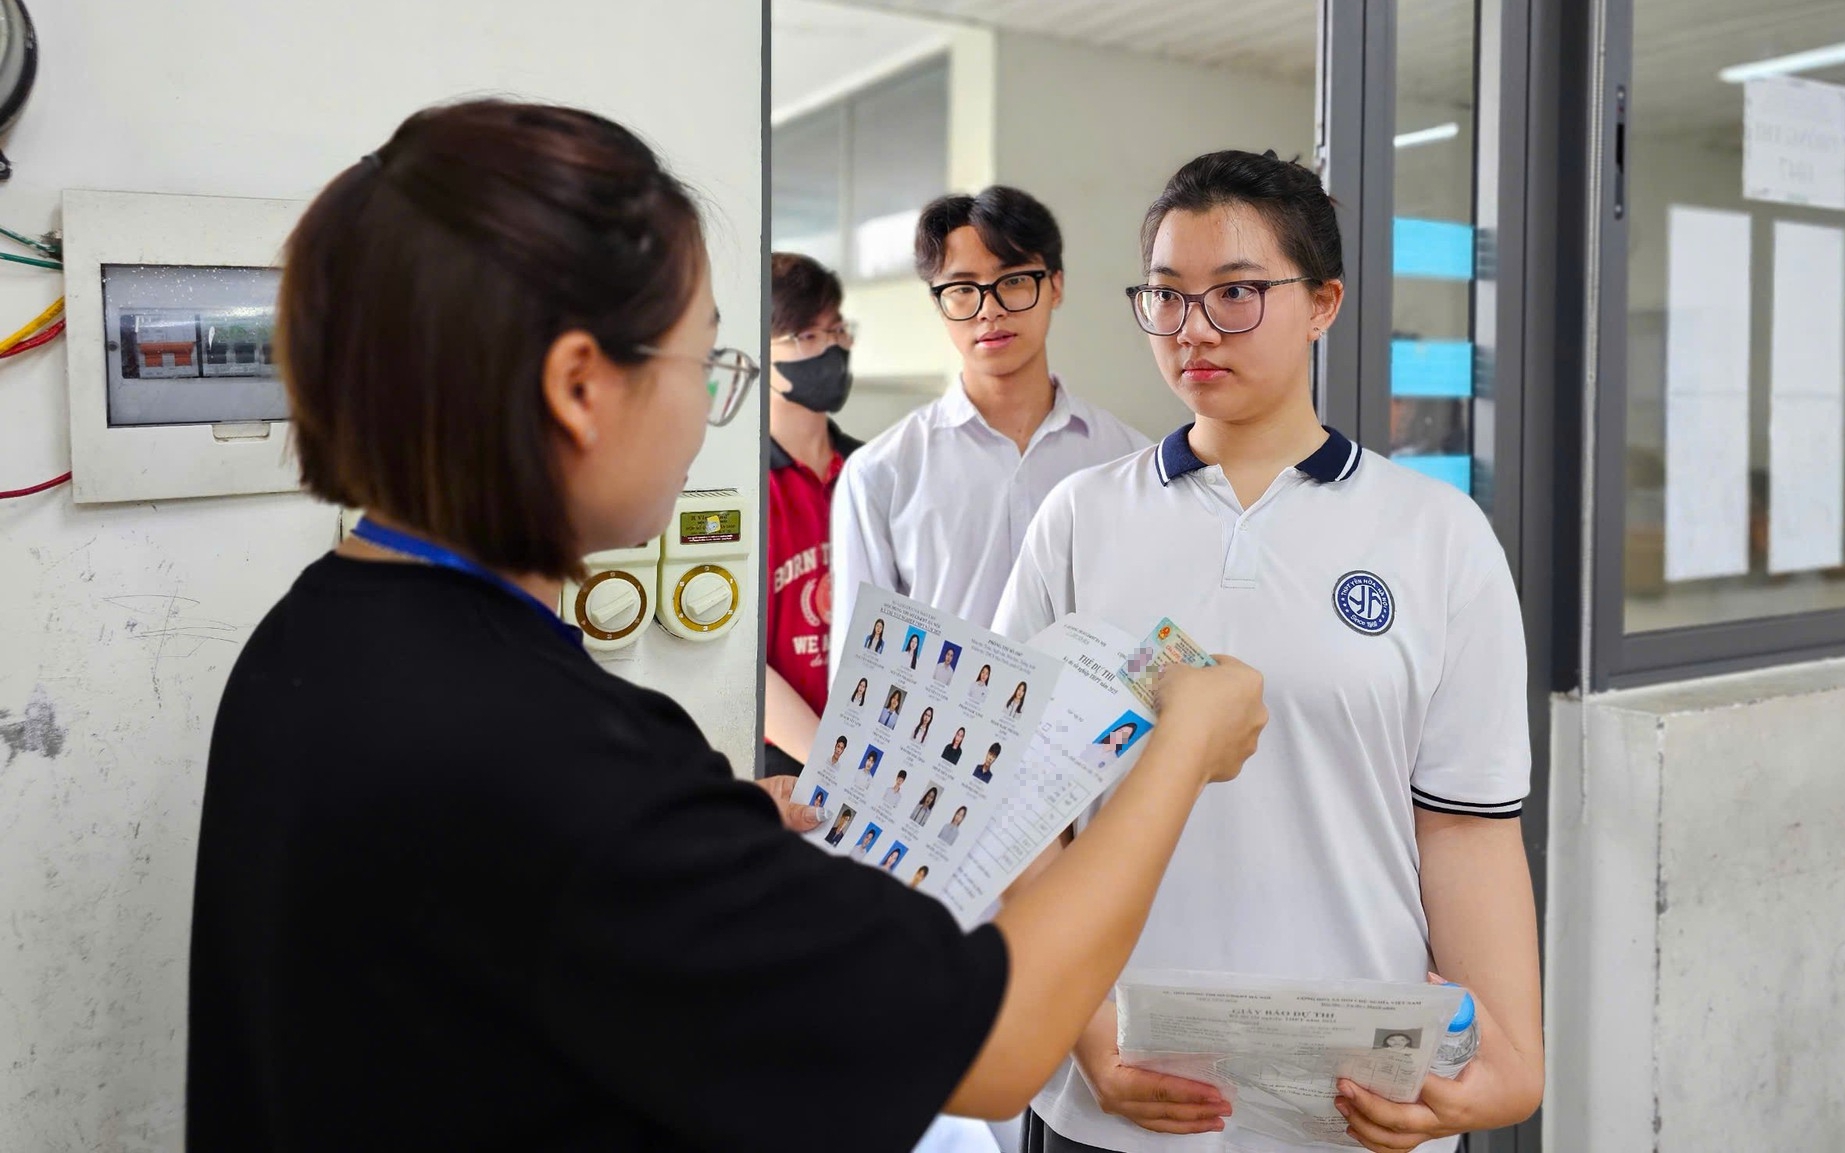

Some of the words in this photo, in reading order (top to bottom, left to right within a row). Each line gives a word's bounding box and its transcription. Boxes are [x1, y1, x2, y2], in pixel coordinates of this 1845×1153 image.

[774, 546, 818, 594] BORN
[792, 634, 819, 655] WE
[1079, 654, 1095, 668] THẺ
[1091, 663, 1105, 674] DỰ
[1101, 670, 1116, 681] THI
